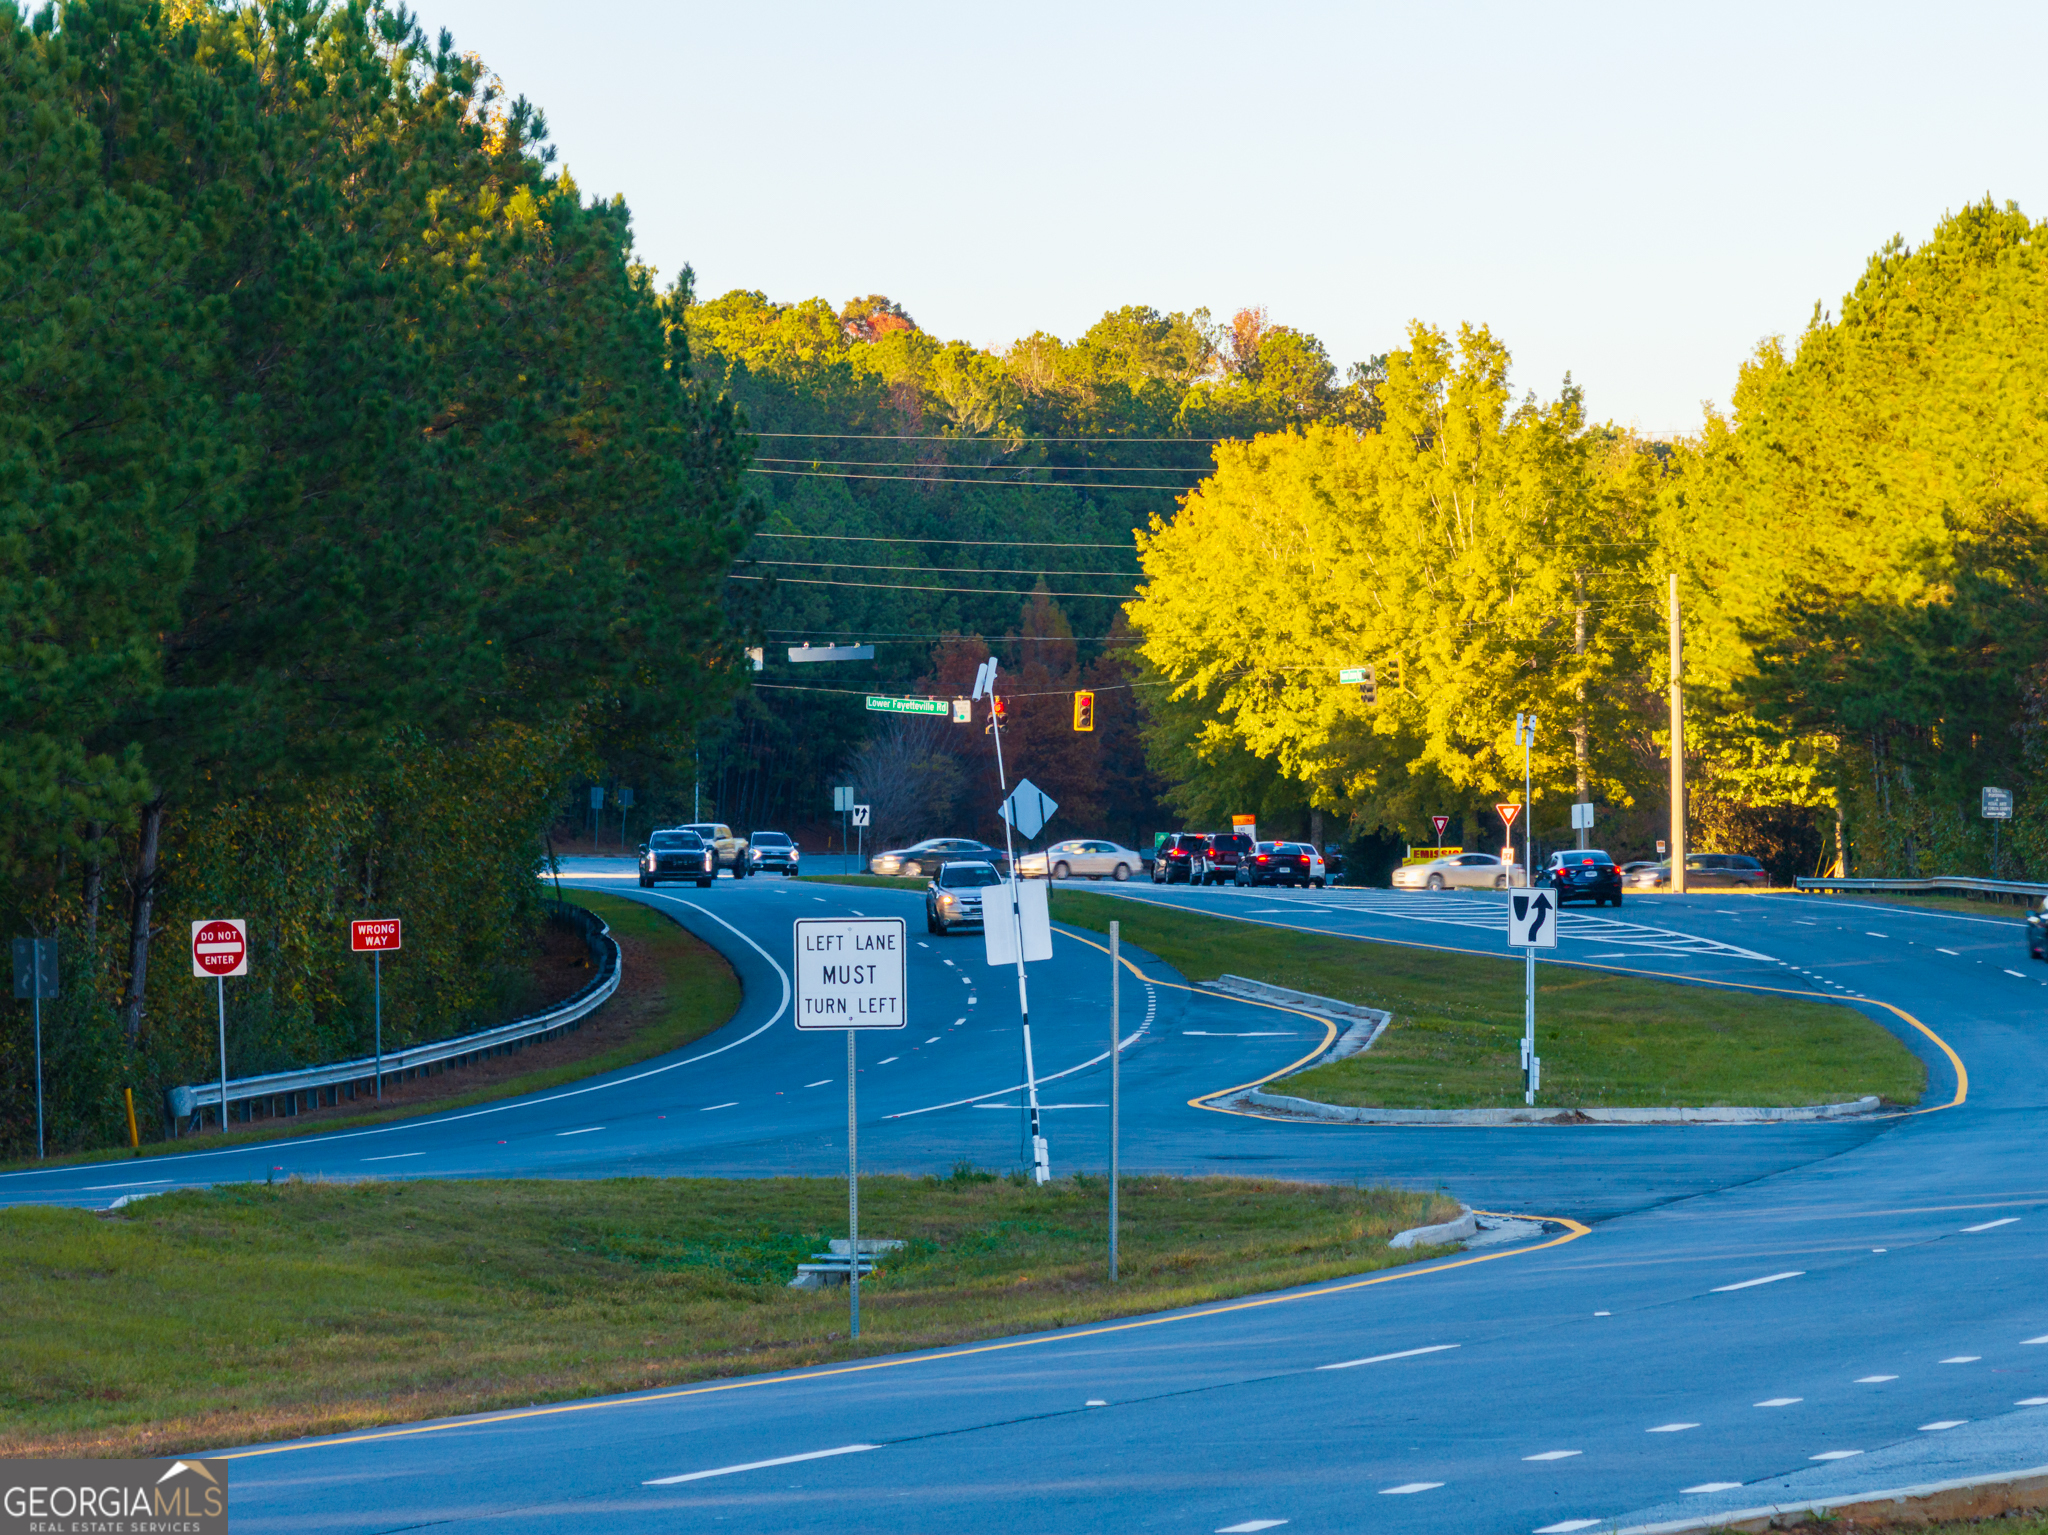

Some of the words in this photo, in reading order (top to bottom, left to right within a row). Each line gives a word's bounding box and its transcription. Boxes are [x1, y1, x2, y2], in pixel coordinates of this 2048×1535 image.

[868, 698, 890, 708] Lower
[893, 699, 934, 712] Fayetteville
[936, 703, 947, 712] Rd
[358, 924, 395, 935] WRONG
[201, 932, 214, 941] DO
[218, 931, 237, 940] NOT
[365, 936, 388, 946] WAY
[806, 935, 843, 951] LEFT
[856, 935, 896, 950] LANE
[205, 955, 234, 965] ENTER
[823, 965, 876, 985] MUST
[805, 998, 847, 1014] TURN
[858, 997, 896, 1013] LEFT
